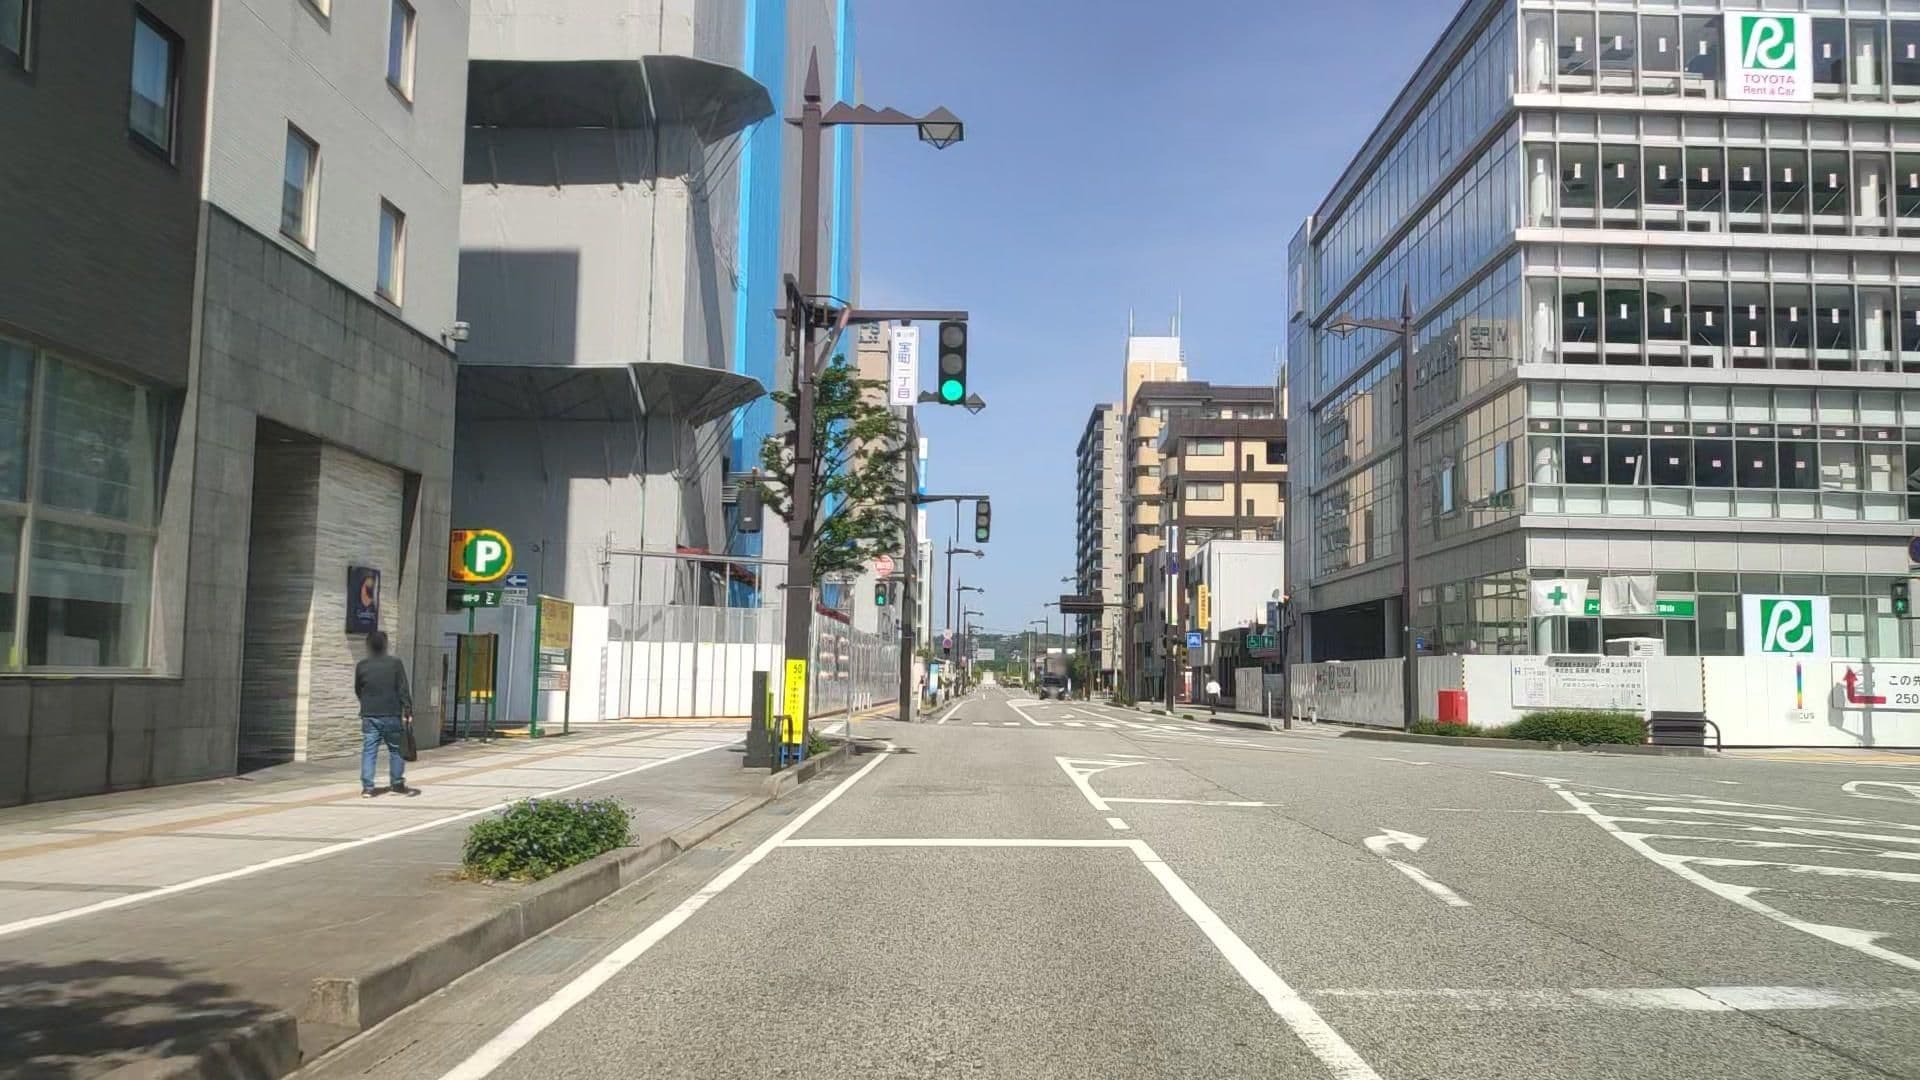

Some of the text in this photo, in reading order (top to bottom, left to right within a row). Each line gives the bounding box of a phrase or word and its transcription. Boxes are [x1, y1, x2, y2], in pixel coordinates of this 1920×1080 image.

[1743, 73, 1795, 85] TOYOTA
[1743, 86, 1767, 95] Rent
[1778, 86, 1796, 96] Car
[897, 341, 913, 399] 宝町一丁目
[475, 540, 501, 573] P
[1895, 693, 1920, 704] 250
